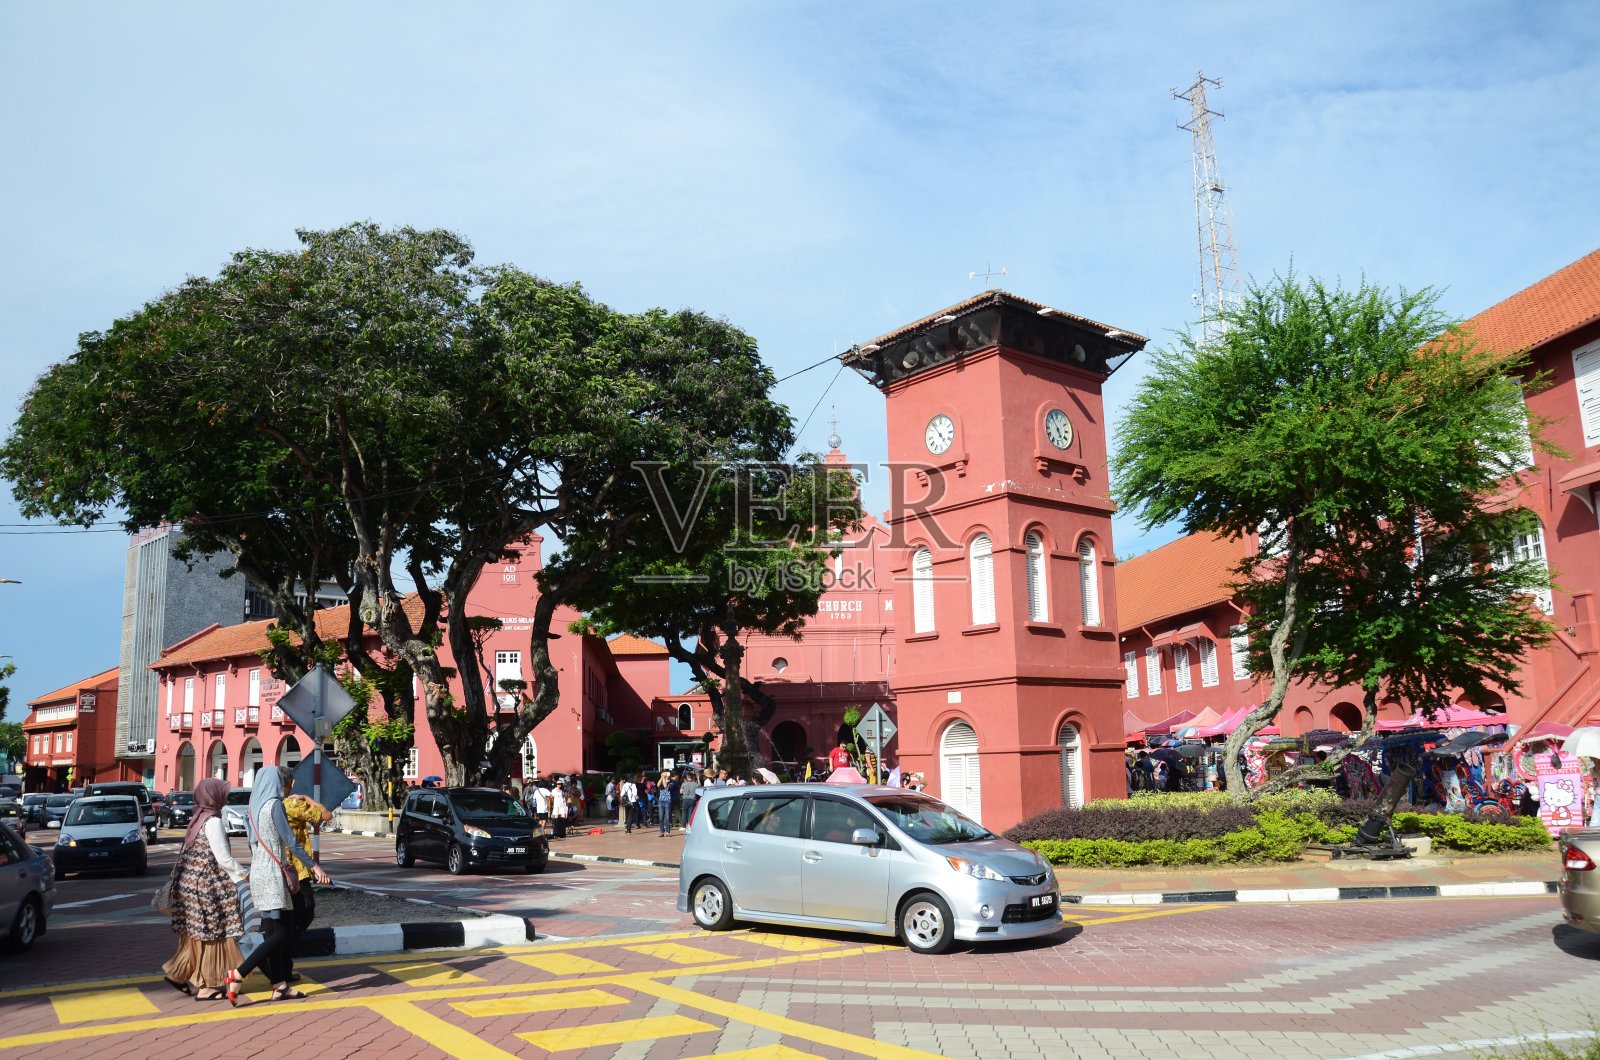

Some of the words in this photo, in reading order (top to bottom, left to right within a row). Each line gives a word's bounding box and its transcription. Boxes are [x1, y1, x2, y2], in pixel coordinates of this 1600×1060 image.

[503, 565, 516, 573] AD
[503, 574, 516, 582] 1951
[818, 600, 863, 612] CHURCH
[830, 612, 852, 620] 1753
